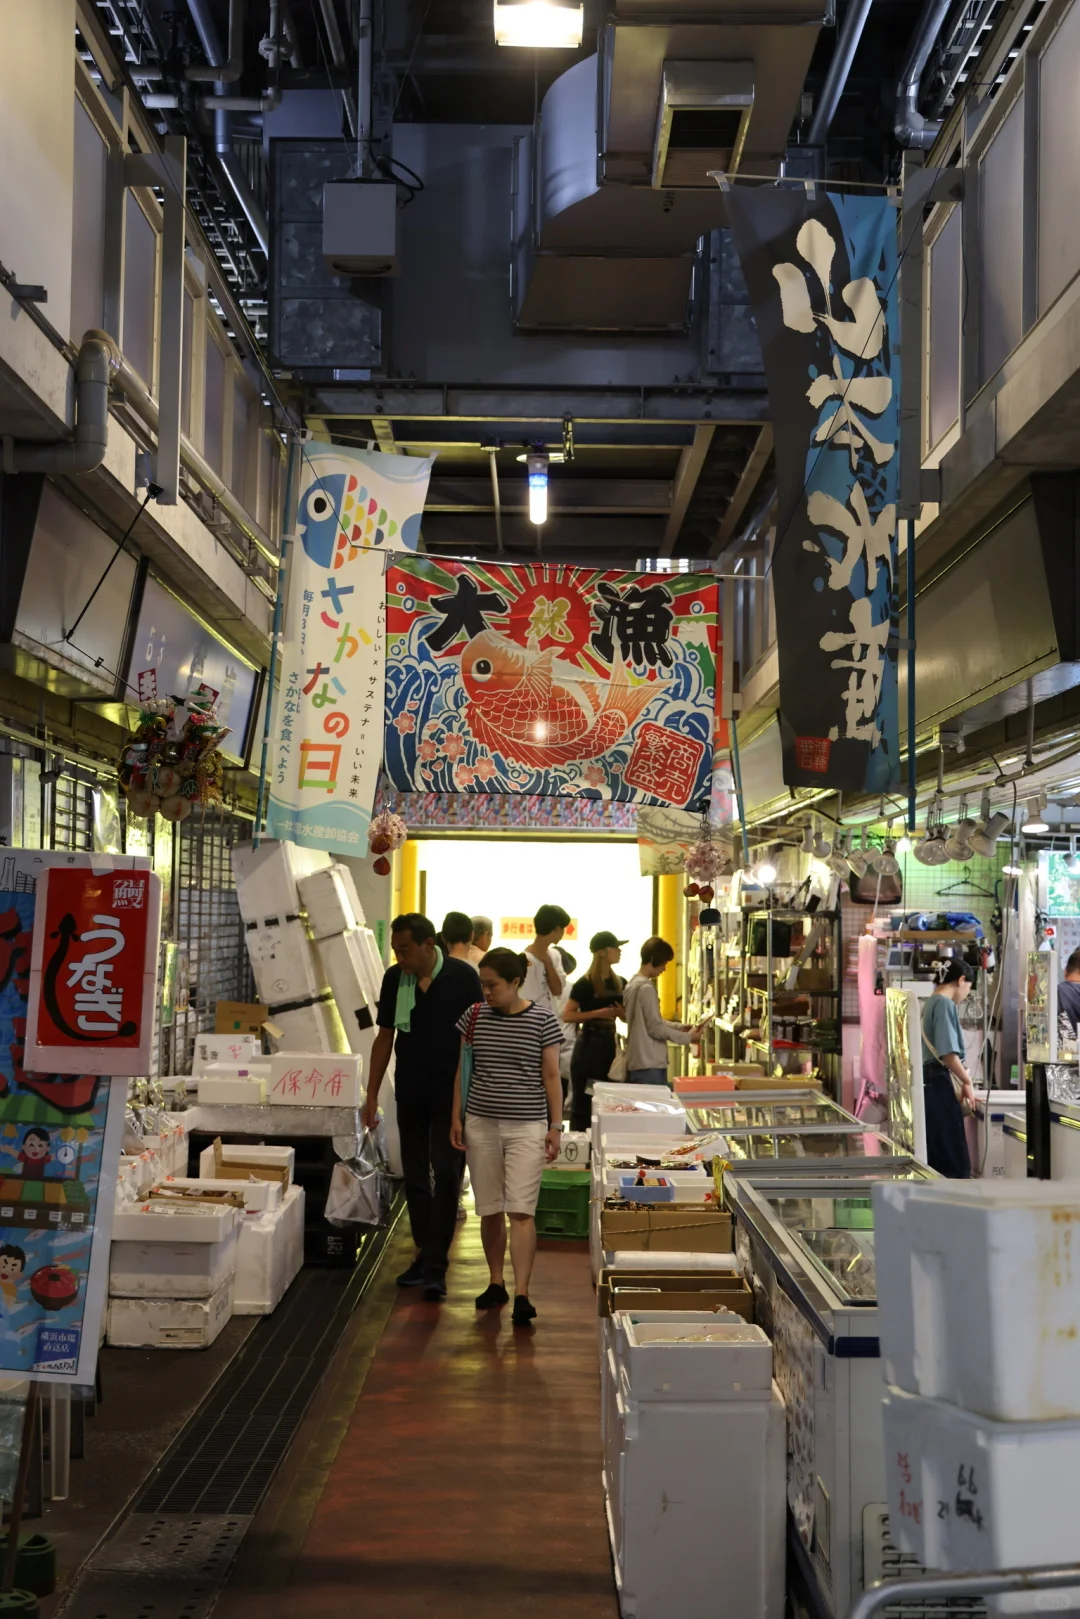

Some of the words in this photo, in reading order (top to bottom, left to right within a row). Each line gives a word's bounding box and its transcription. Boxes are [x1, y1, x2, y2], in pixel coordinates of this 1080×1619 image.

[425, 573, 509, 652] 大
[528, 595, 575, 642] 祝
[591, 581, 675, 669] 漁
[277, 671, 299, 784] さかなを食べよう
[298, 577, 373, 794] さかなの日
[66, 914, 126, 1032] うなぎ
